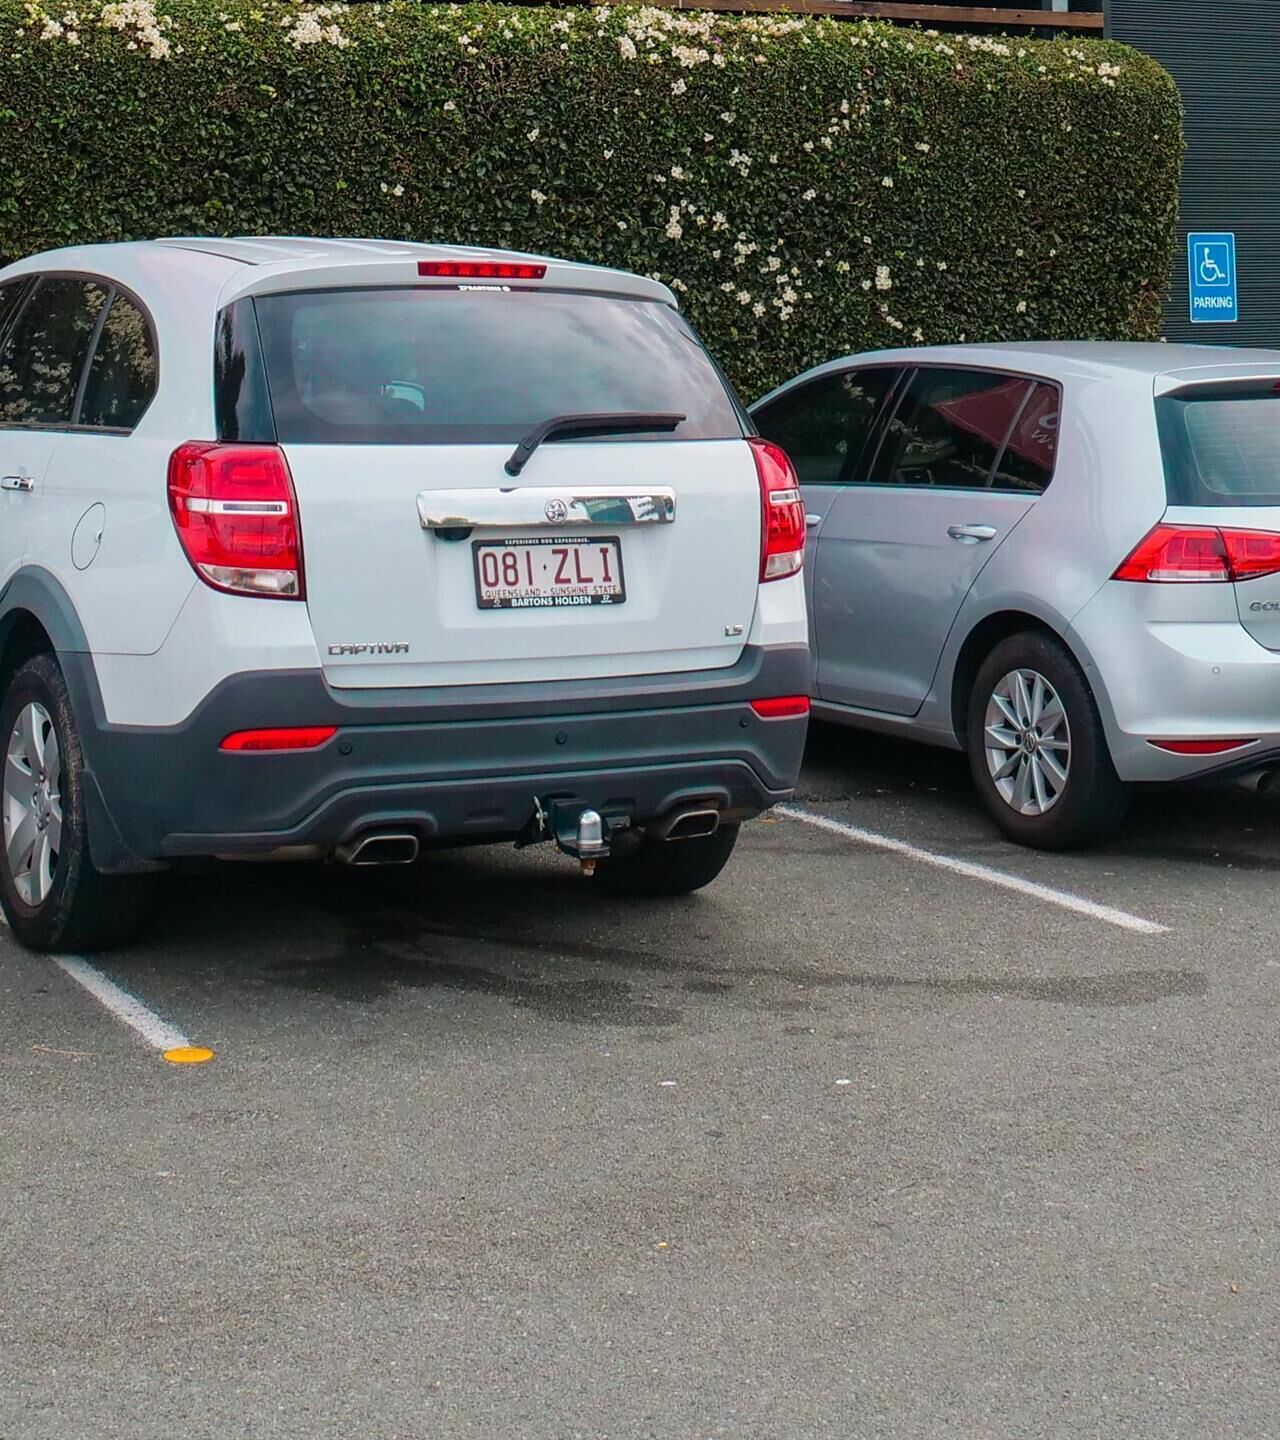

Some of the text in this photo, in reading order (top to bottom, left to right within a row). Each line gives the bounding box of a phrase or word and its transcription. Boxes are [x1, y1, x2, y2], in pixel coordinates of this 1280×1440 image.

[1193, 296, 1233, 308] PARKING
[485, 588, 540, 599] QUEENSLAND
[550, 586, 589, 596] SUNSHINE
[512, 598, 553, 607] BARTONS
[555, 596, 592, 605] HOLDEN
[328, 641, 409, 655] CAPTIVA
